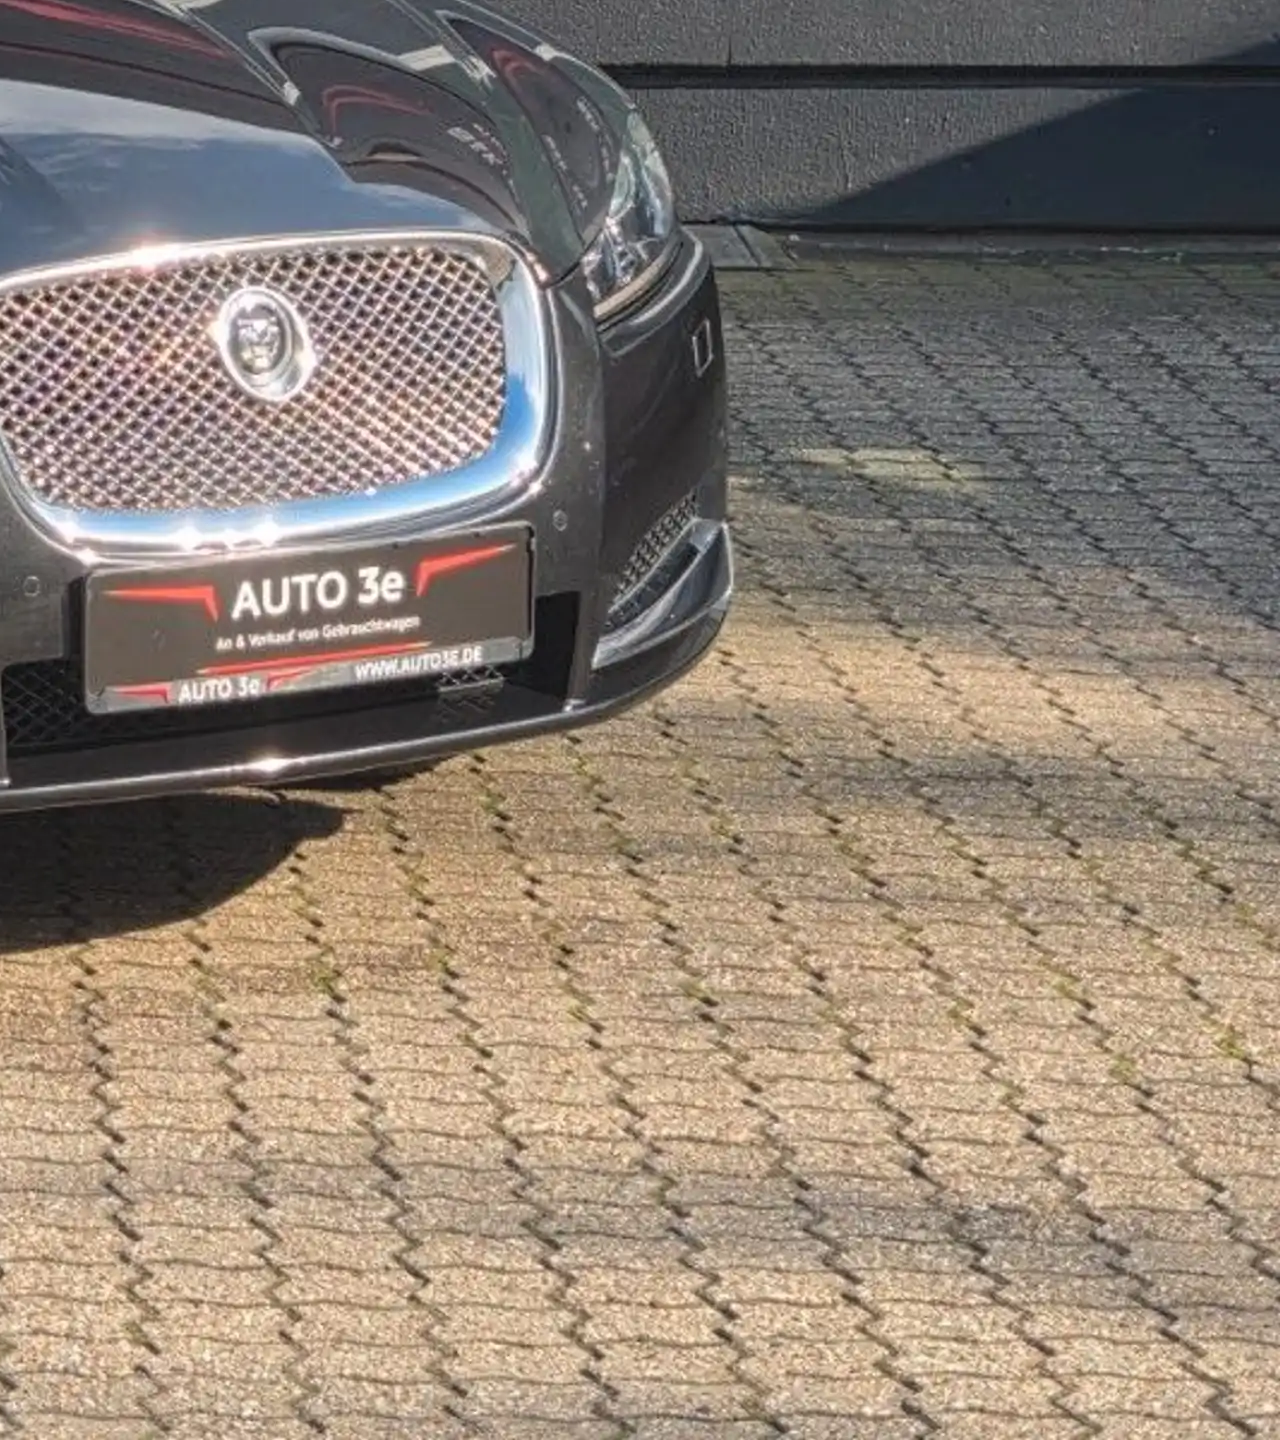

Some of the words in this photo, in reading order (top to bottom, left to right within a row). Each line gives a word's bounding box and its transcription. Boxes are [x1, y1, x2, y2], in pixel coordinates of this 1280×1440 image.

[230, 571, 348, 621] AUTO
[357, 565, 406, 606] 3e
[215, 636, 232, 652] An
[235, 635, 247, 650] &
[248, 630, 295, 648] Verkauf
[297, 629, 319, 643] von
[322, 615, 422, 640] Gebrauchtwagen
[178, 680, 234, 704] AUTO
[238, 677, 262, 698] 3e
